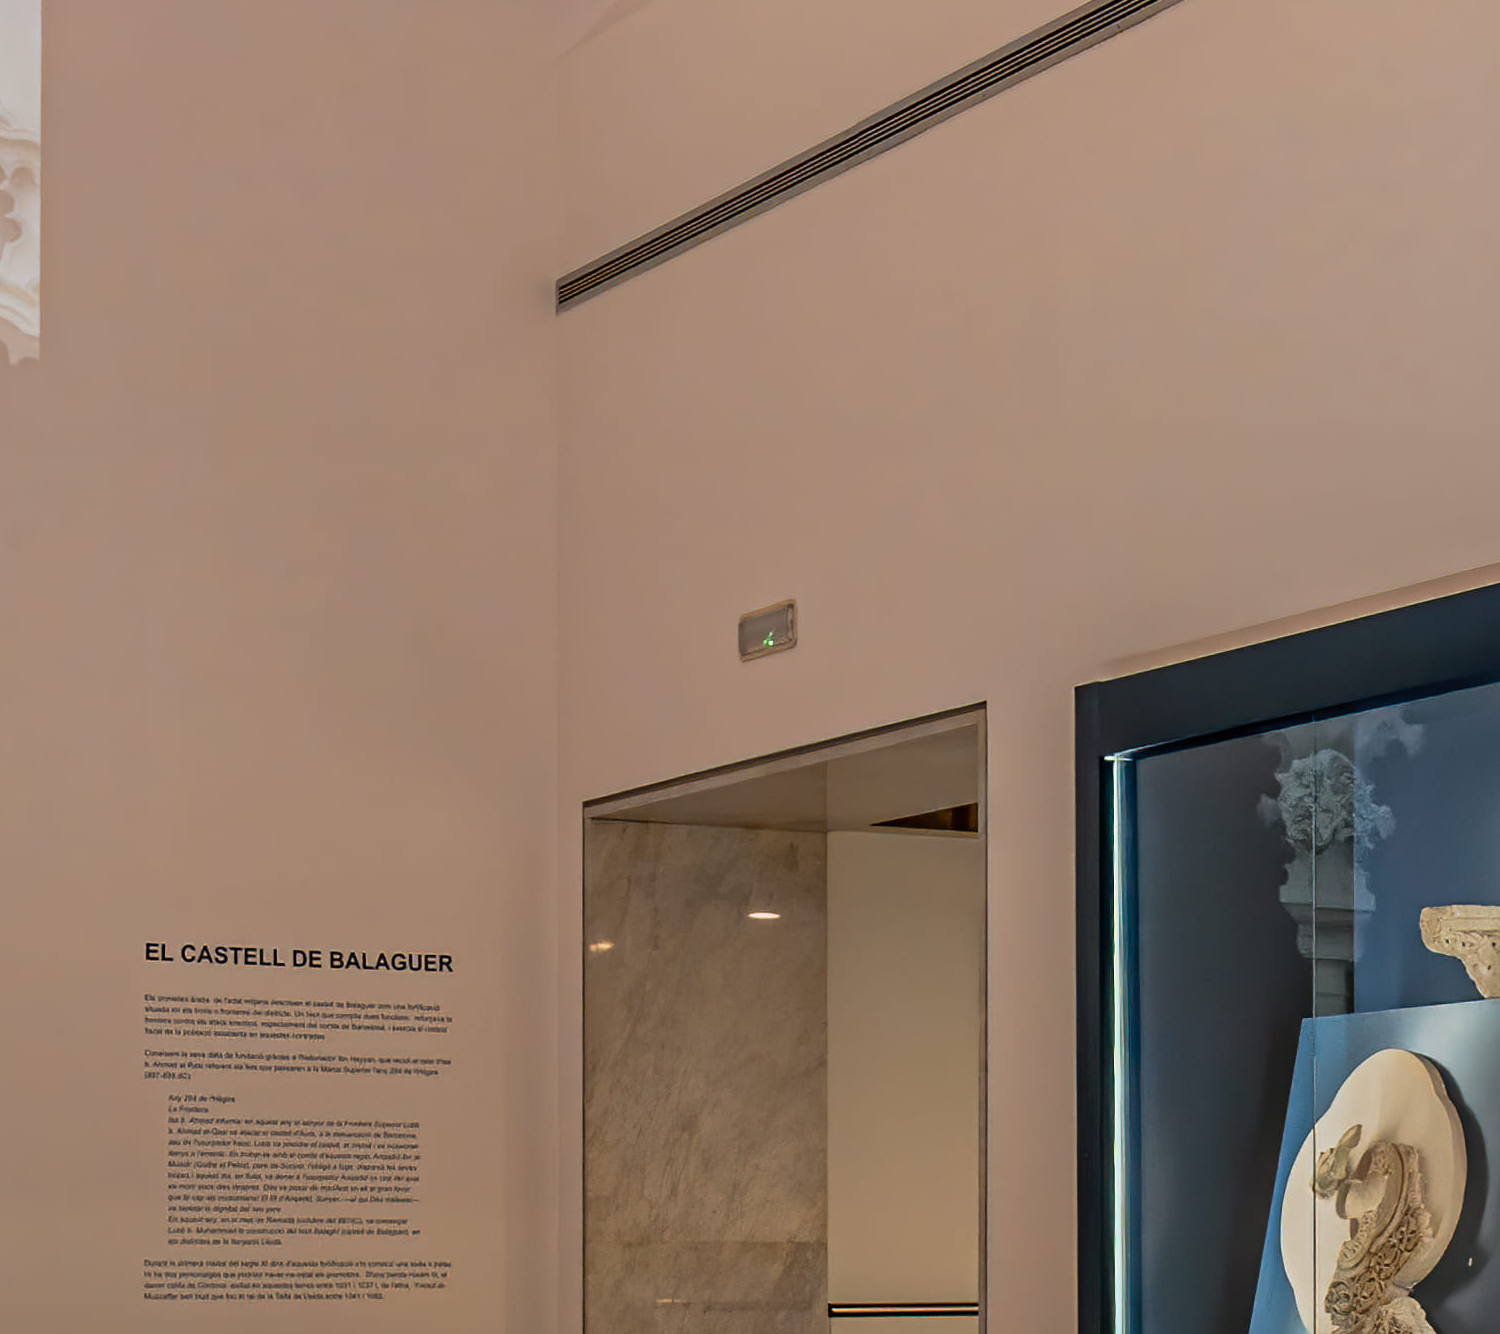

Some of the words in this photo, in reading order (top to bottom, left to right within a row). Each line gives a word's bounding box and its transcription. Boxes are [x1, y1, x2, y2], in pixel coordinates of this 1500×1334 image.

[145, 942, 174, 962] EL
[180, 944, 286, 967] CASTELL
[293, 949, 322, 969] DE
[330, 951, 454, 973] BALAGUER
